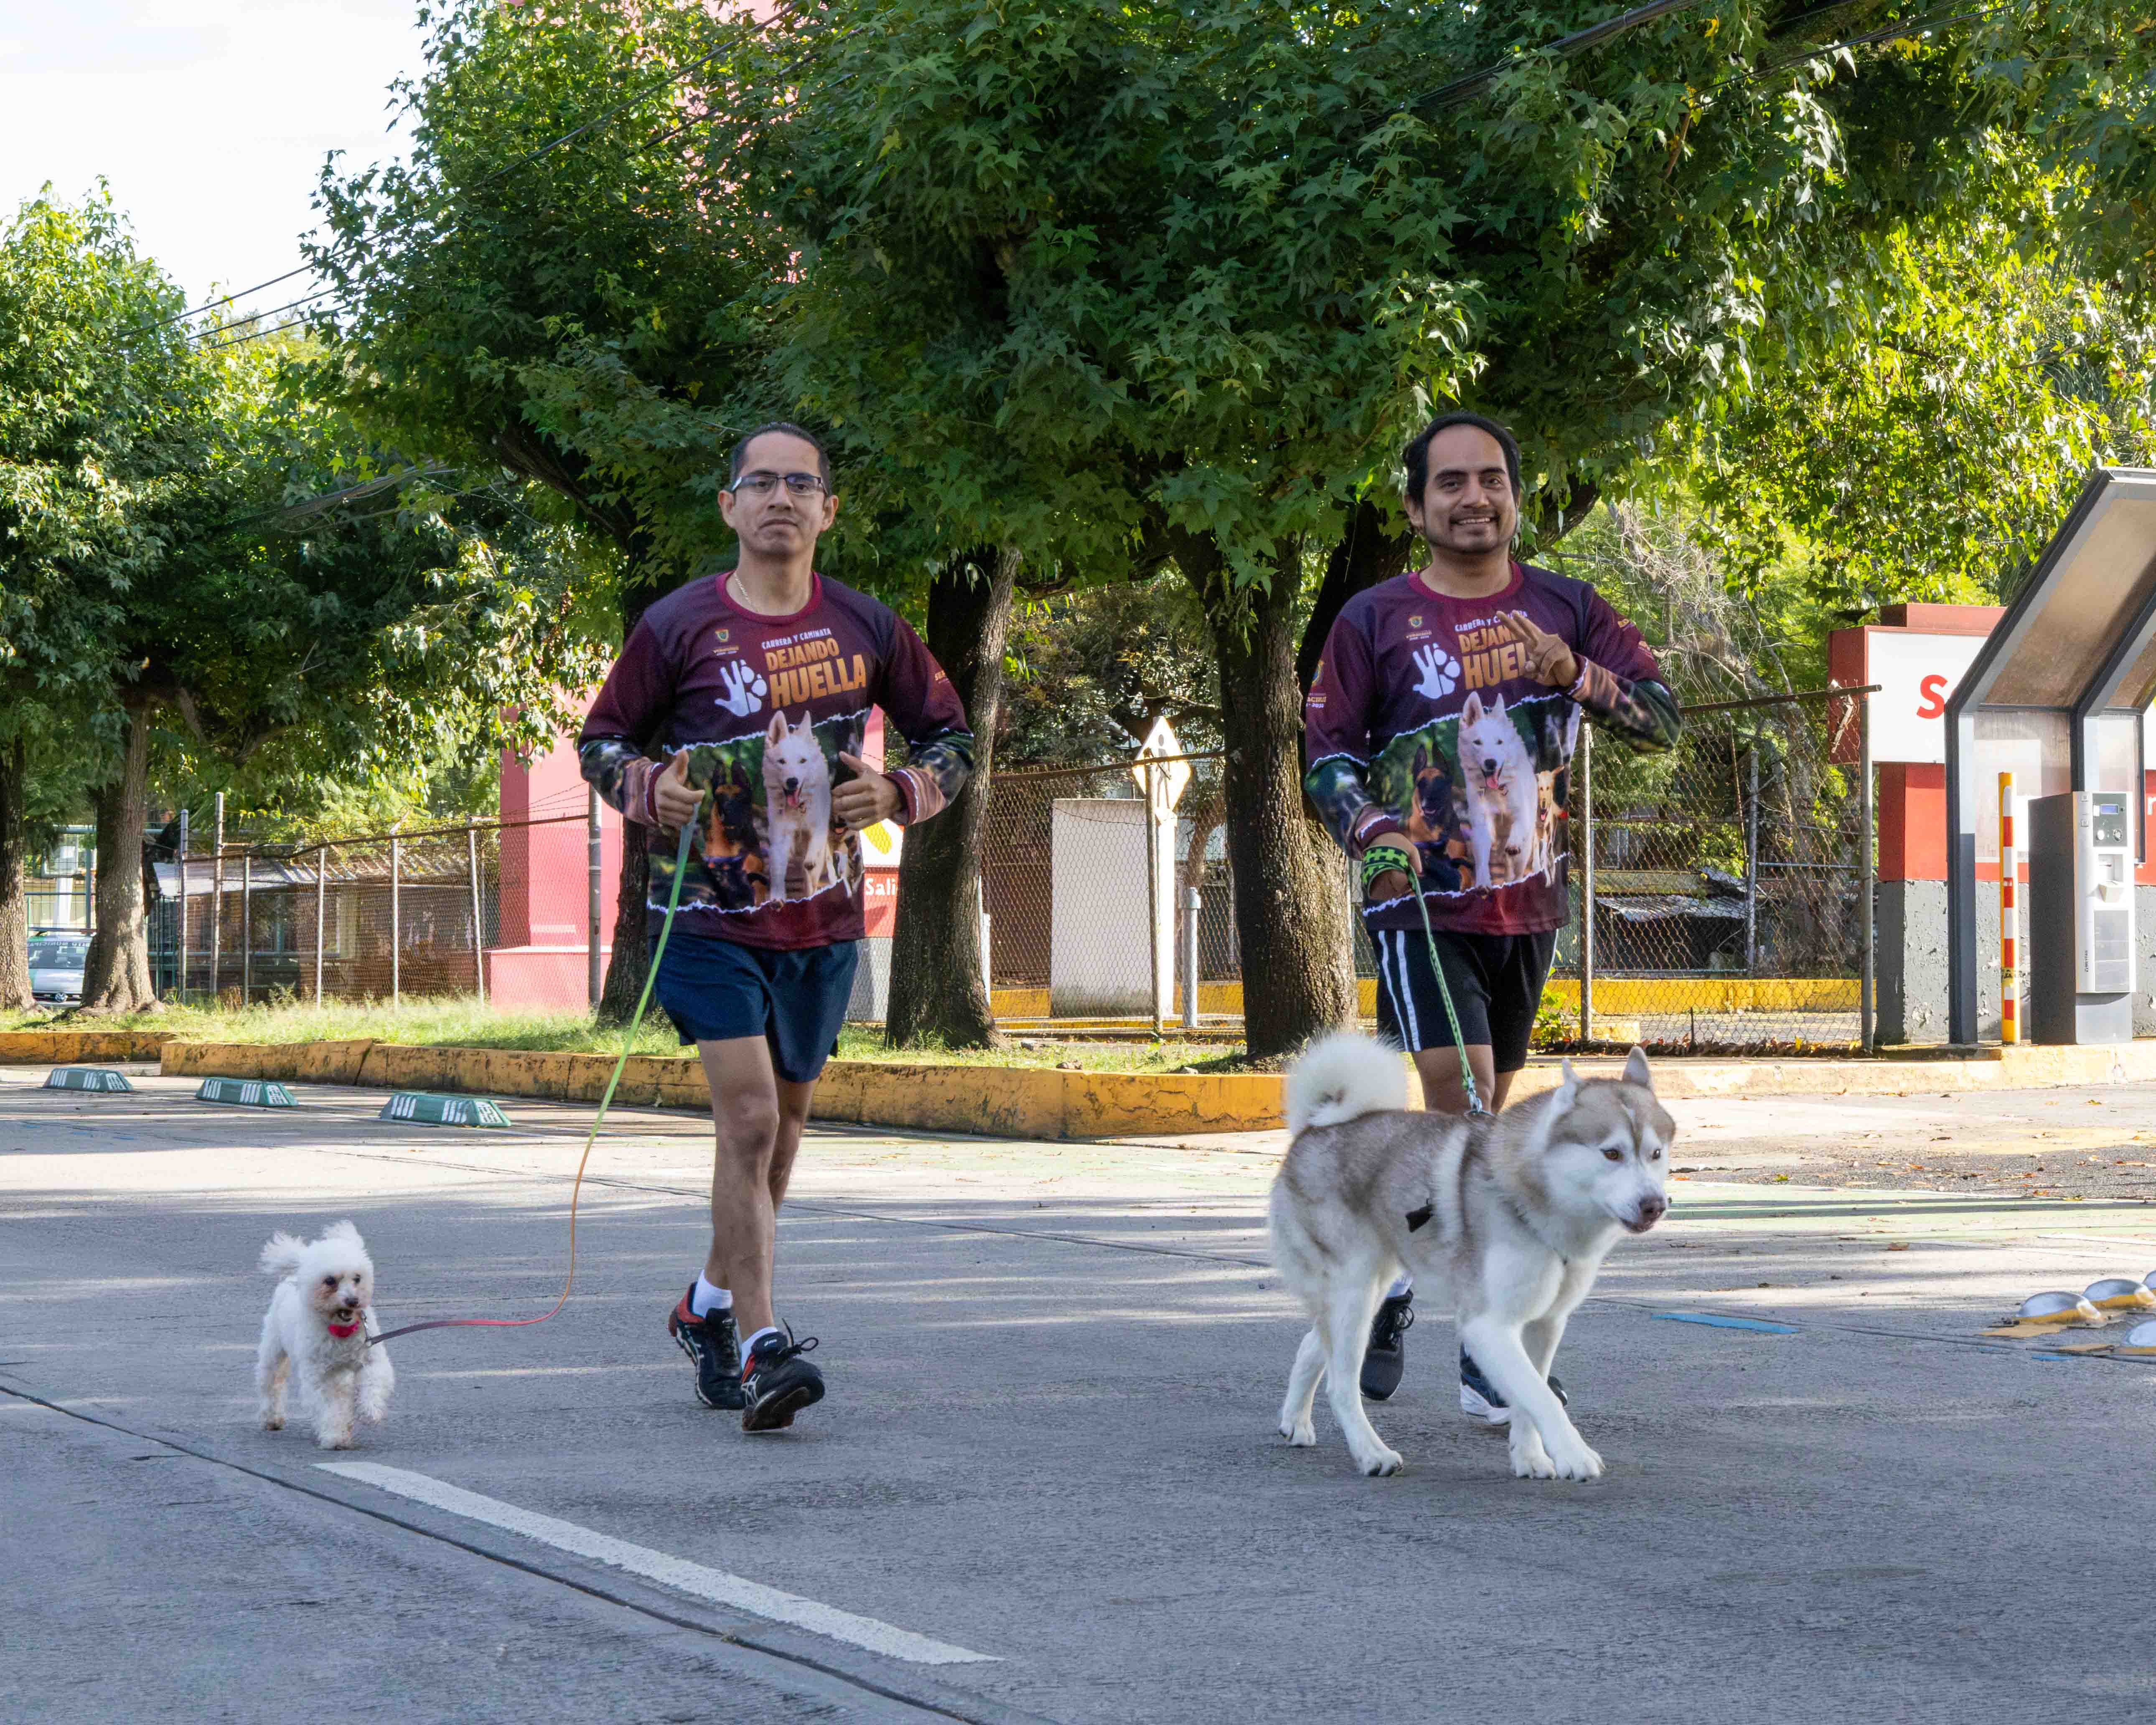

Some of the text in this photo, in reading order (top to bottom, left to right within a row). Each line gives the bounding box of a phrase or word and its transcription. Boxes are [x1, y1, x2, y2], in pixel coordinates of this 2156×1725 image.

[762, 637, 792, 649] CARRERA
[799, 627, 832, 641] CAMINATA
[1454, 618, 1485, 632] CARRERA
[1458, 625, 1515, 654] DEJAN
[765, 637, 839, 671] DEJANDO
[1462, 641, 1525, 690] HUEL
[769, 654, 867, 709] HUELLA
[1916, 674, 1948, 719] S
[865, 878, 896, 896] Sali
